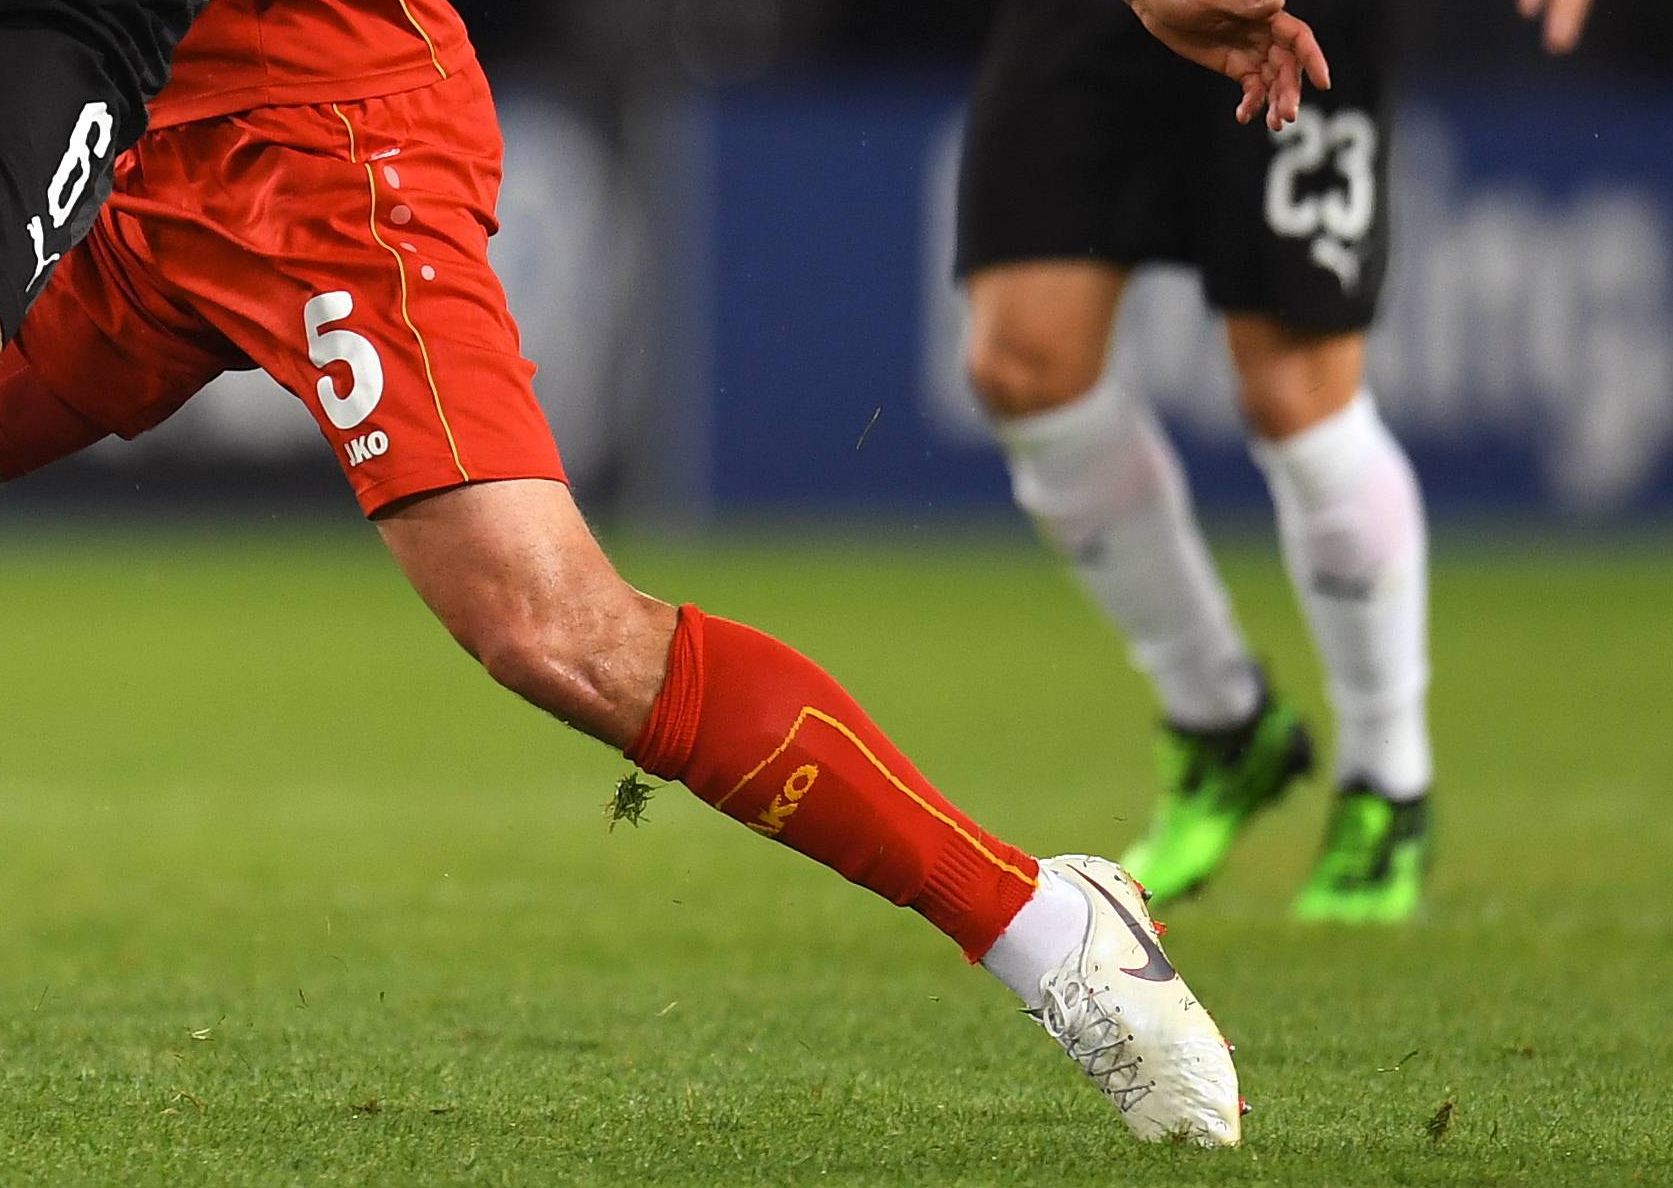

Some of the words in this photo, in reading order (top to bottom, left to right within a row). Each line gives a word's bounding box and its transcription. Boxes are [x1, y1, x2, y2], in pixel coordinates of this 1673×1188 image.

[47, 101, 113, 229] 6
[1266, 107, 1379, 240] 23
[304, 290, 384, 430] 5
